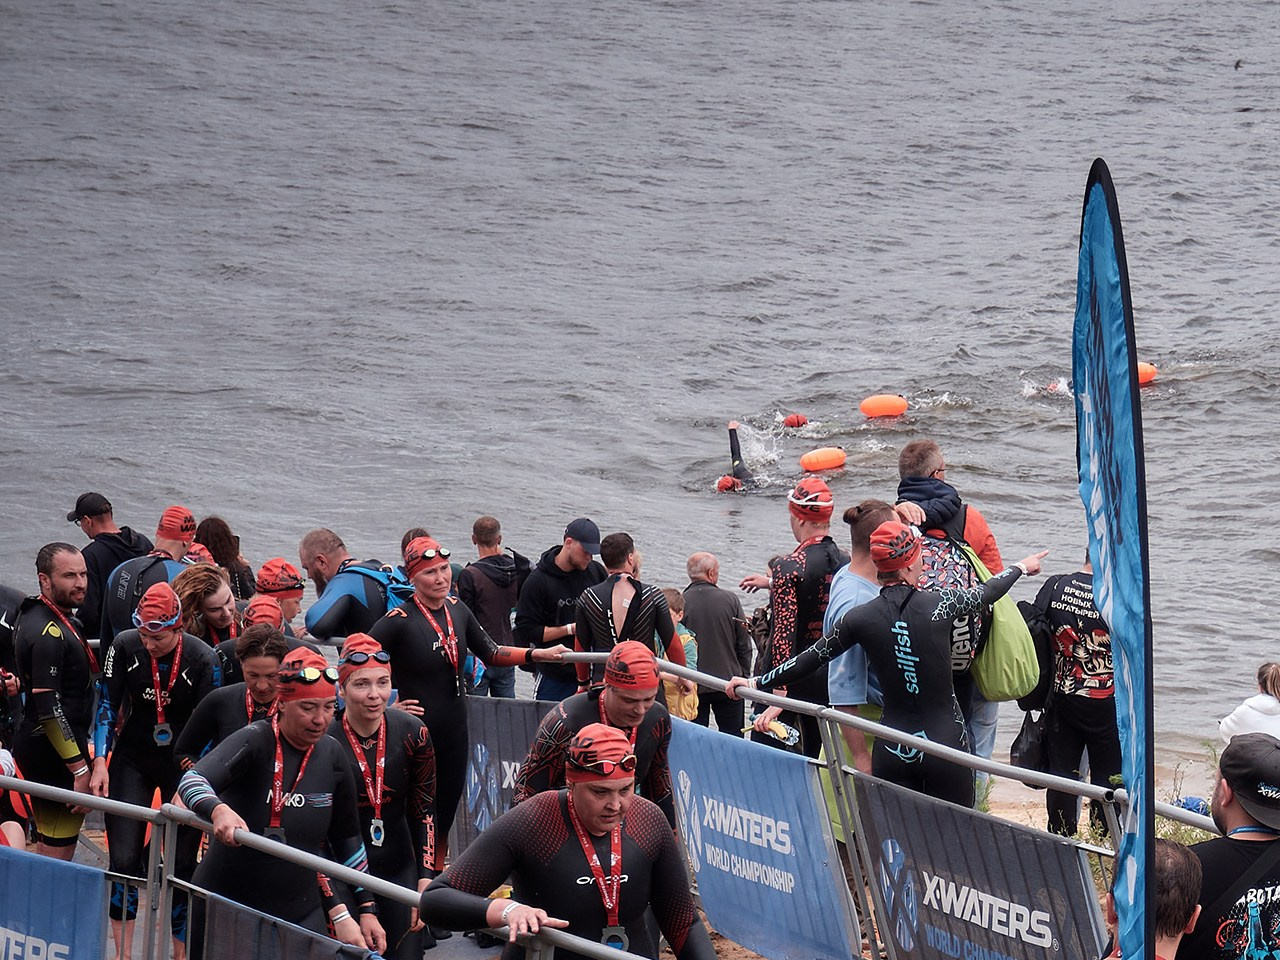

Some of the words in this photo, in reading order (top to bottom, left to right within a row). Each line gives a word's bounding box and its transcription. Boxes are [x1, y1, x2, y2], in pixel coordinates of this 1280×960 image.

[1061, 594, 1092, 609] НОВЫХ
[1064, 586, 1093, 600] ВРЕМЯ
[1051, 601, 1099, 619] БОГАТЫРЕЙ
[892, 620, 920, 695] sailfish
[705, 842, 730, 872] WORLD
[731, 854, 795, 893] CHAMPIONSHIP
[925, 923, 960, 958] WORLD
